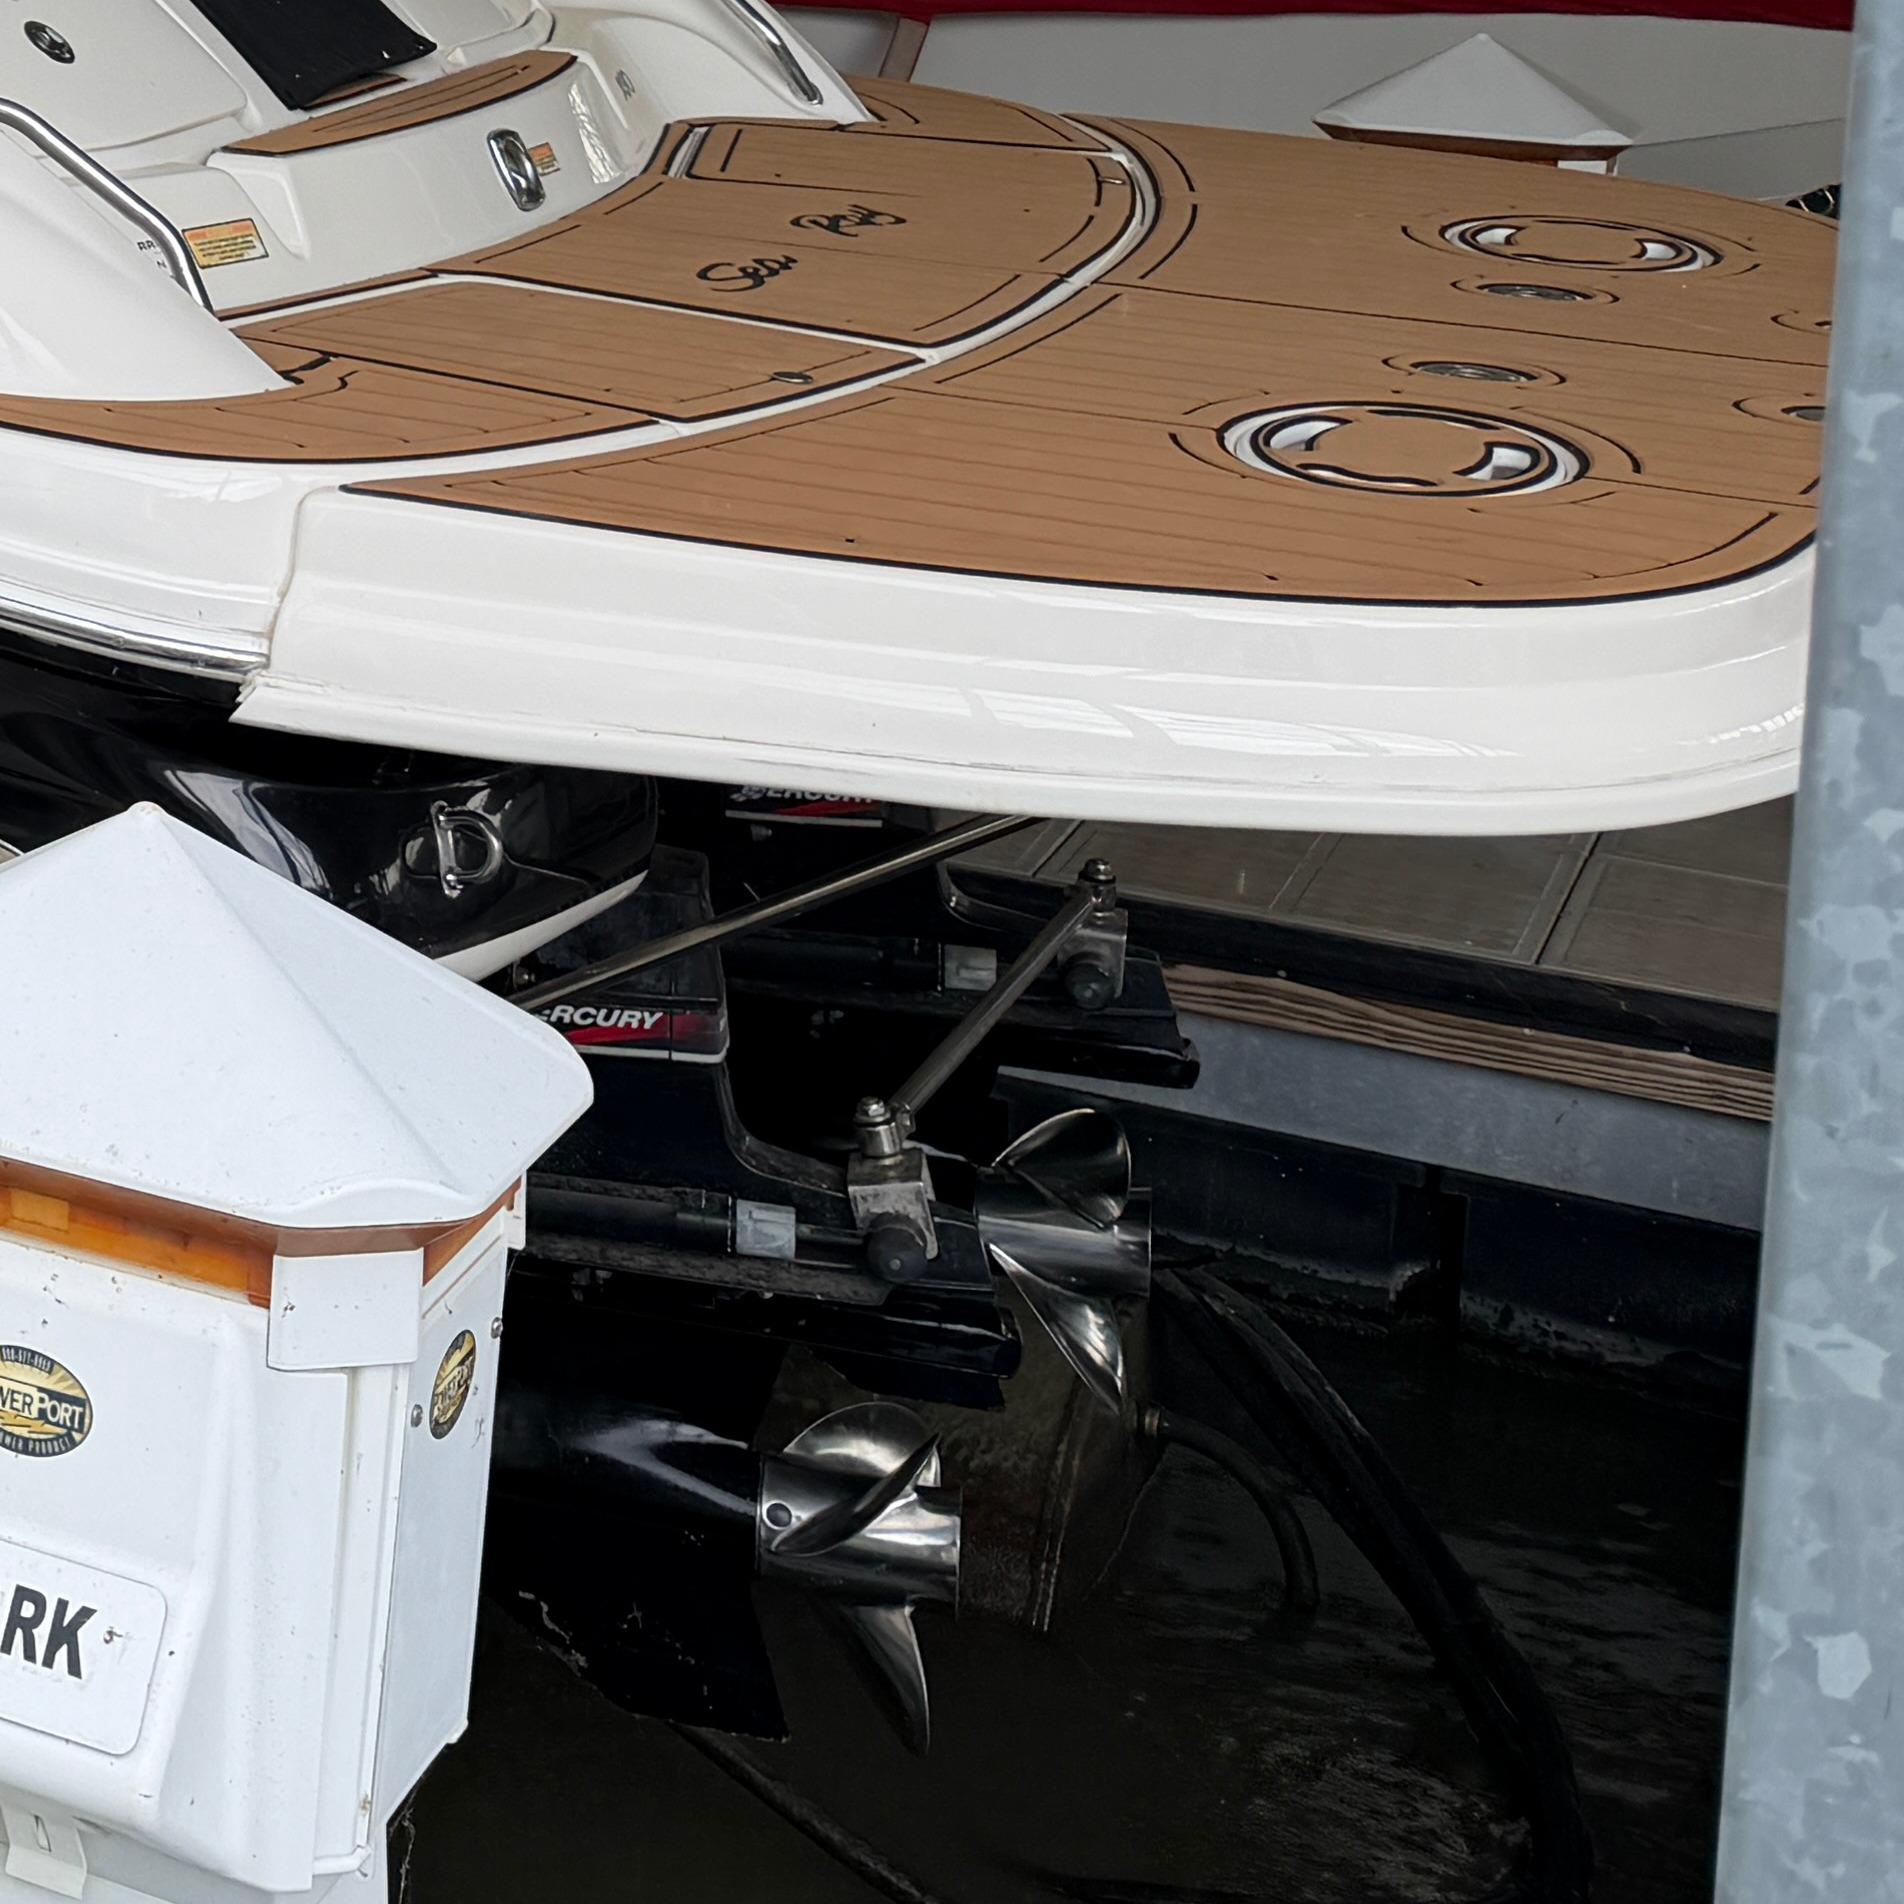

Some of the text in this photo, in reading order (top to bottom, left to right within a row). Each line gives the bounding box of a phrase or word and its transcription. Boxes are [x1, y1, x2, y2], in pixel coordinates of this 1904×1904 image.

[696, 204, 907, 293] Sea Ray
[536, 1004, 664, 1030] RCURY
